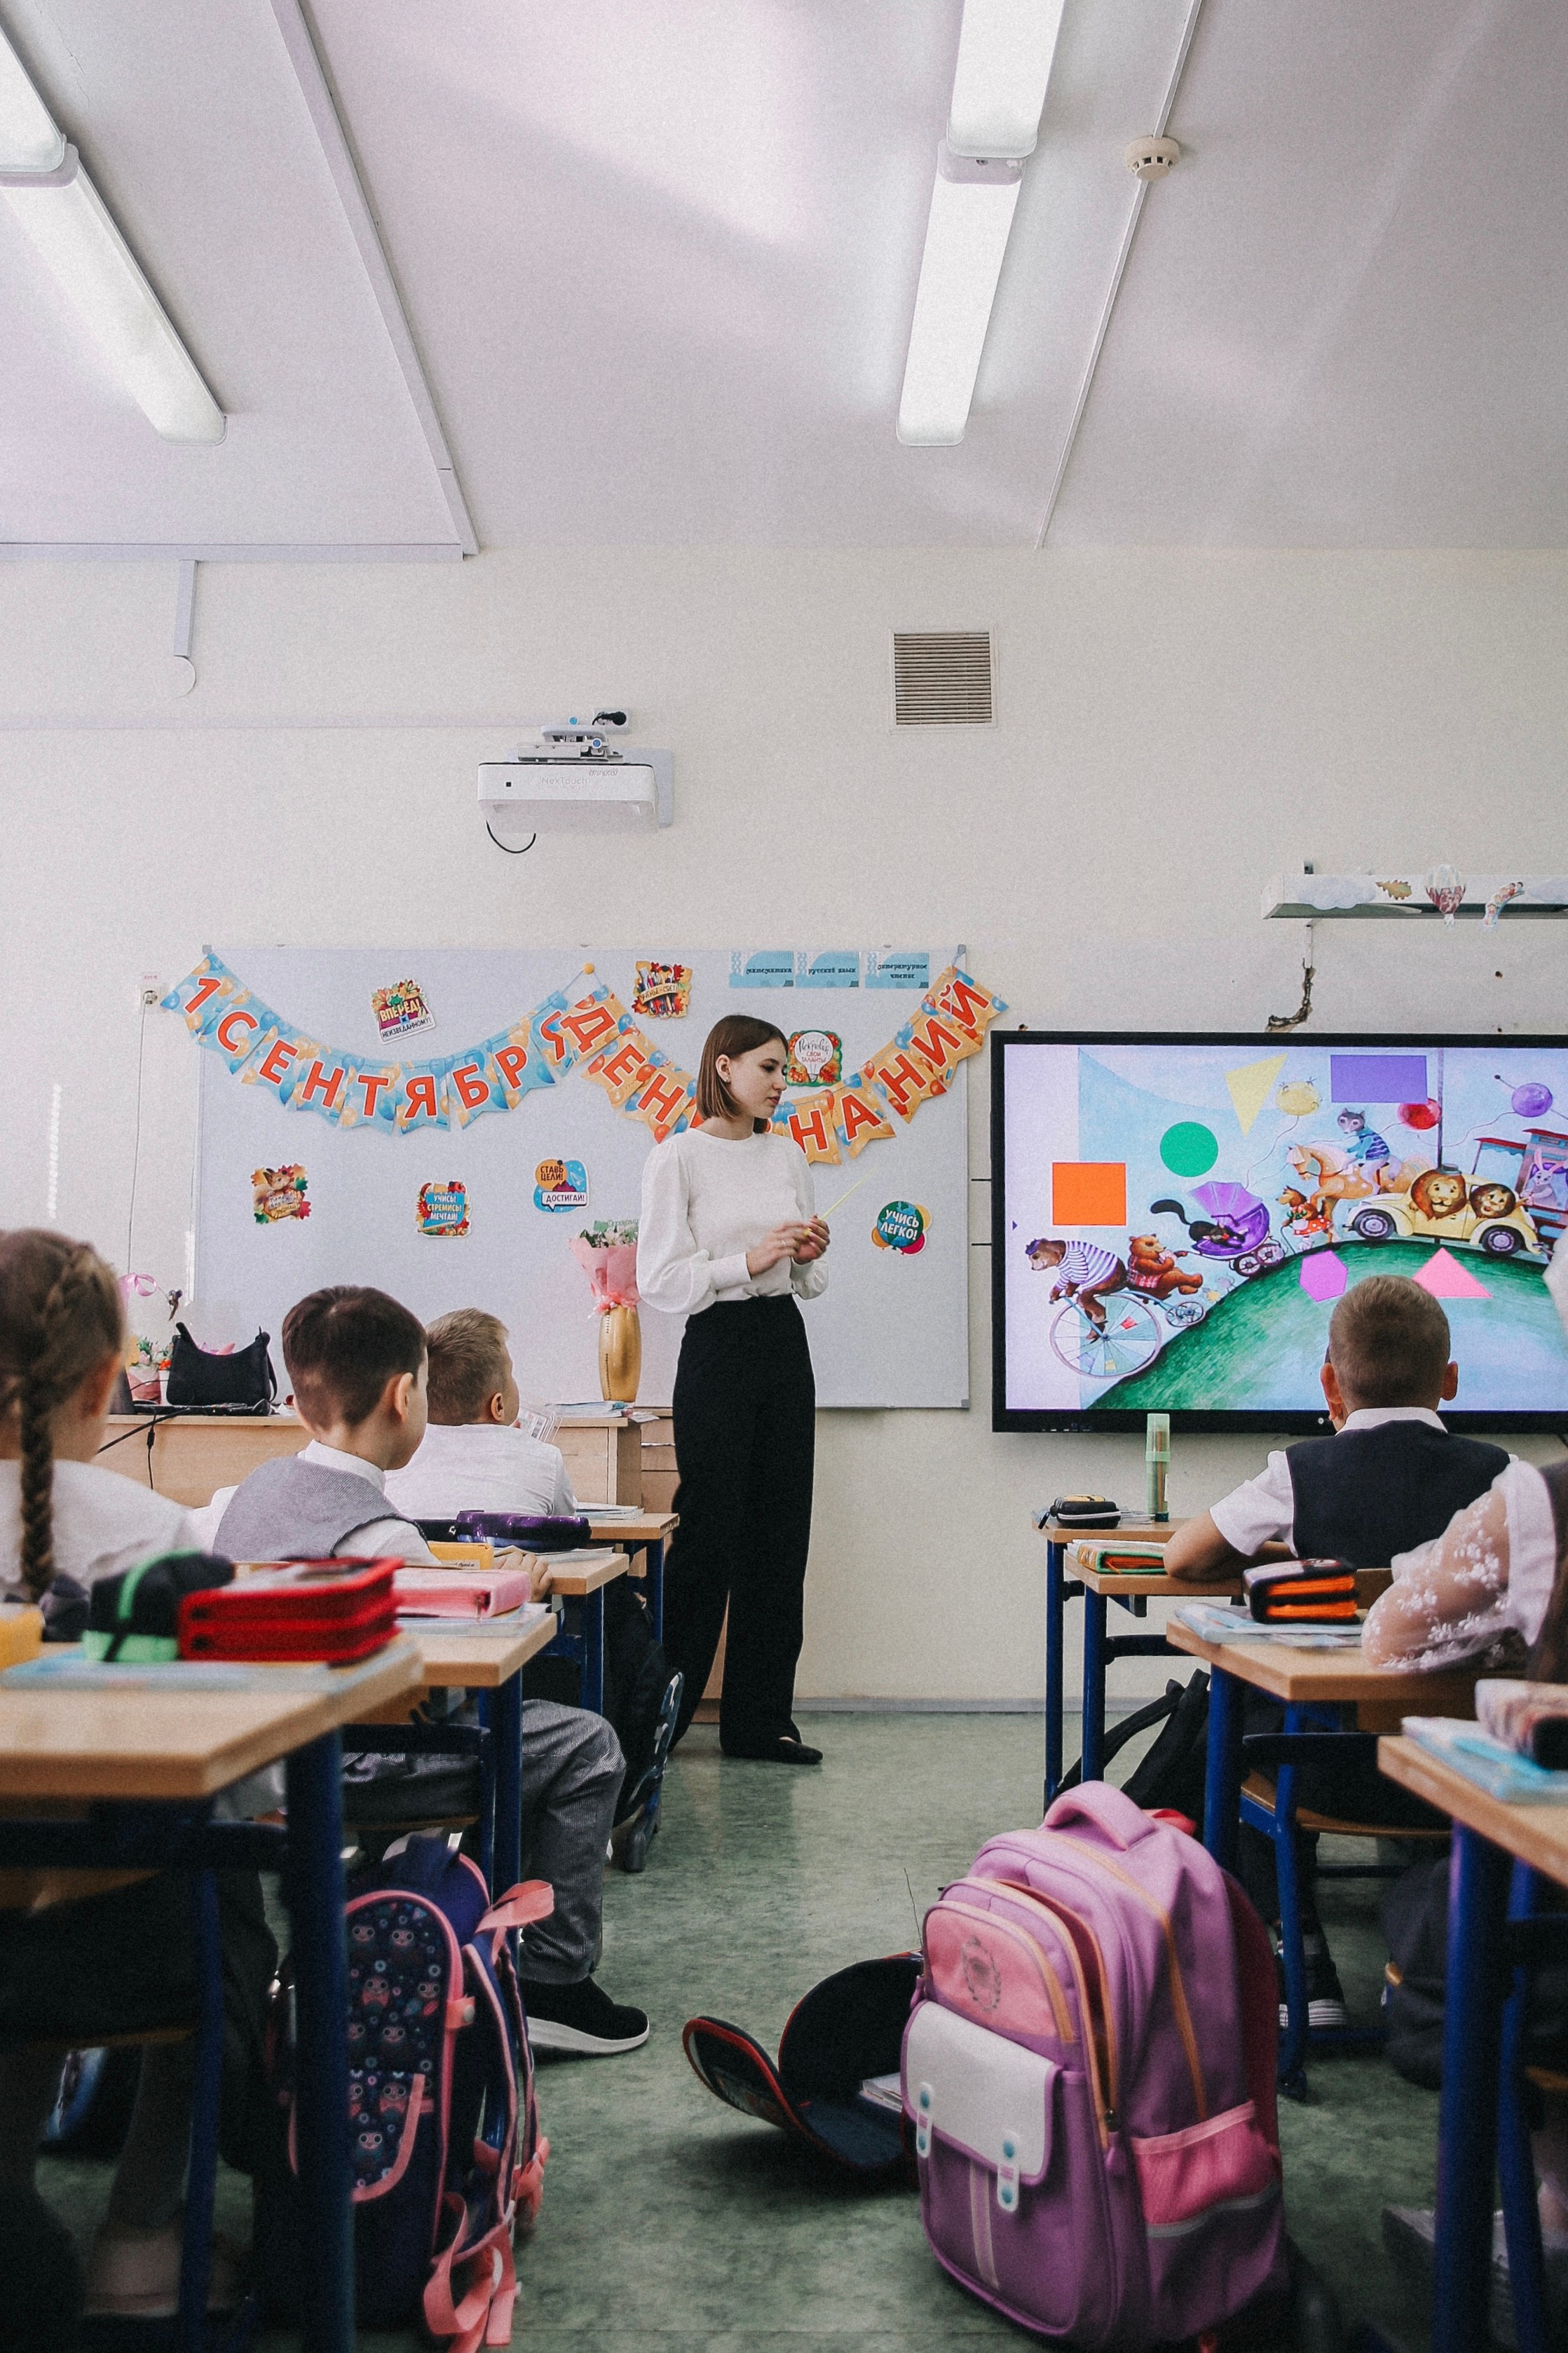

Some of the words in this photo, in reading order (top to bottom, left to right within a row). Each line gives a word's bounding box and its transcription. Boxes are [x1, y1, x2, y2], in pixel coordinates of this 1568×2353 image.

[541, 776, 588, 785] NexTouch
[808, 967, 836, 975] русский
[379, 998, 421, 1022] ВПЕРЁД!
[185, 978, 221, 1014] 1
[217, 1010, 566, 1120] СЕНТЯБРЯ
[560, 1005, 704, 1129] ДЕН
[764, 979, 990, 1154] НАНИЙ
[540, 1173, 564, 1182] ЦЕЛИ!
[433, 1195, 457, 1203] УЧИСЬ!
[546, 1193, 585, 1204] ДОСТИГАЙ!
[427, 1203, 462, 1212] СТРЕМИСЬ!
[430, 1212, 458, 1221] МЕЧТАЙ!
[885, 1209, 920, 1228] УЧИСЬ
[880, 1221, 918, 1241] ЛЕГКО!
